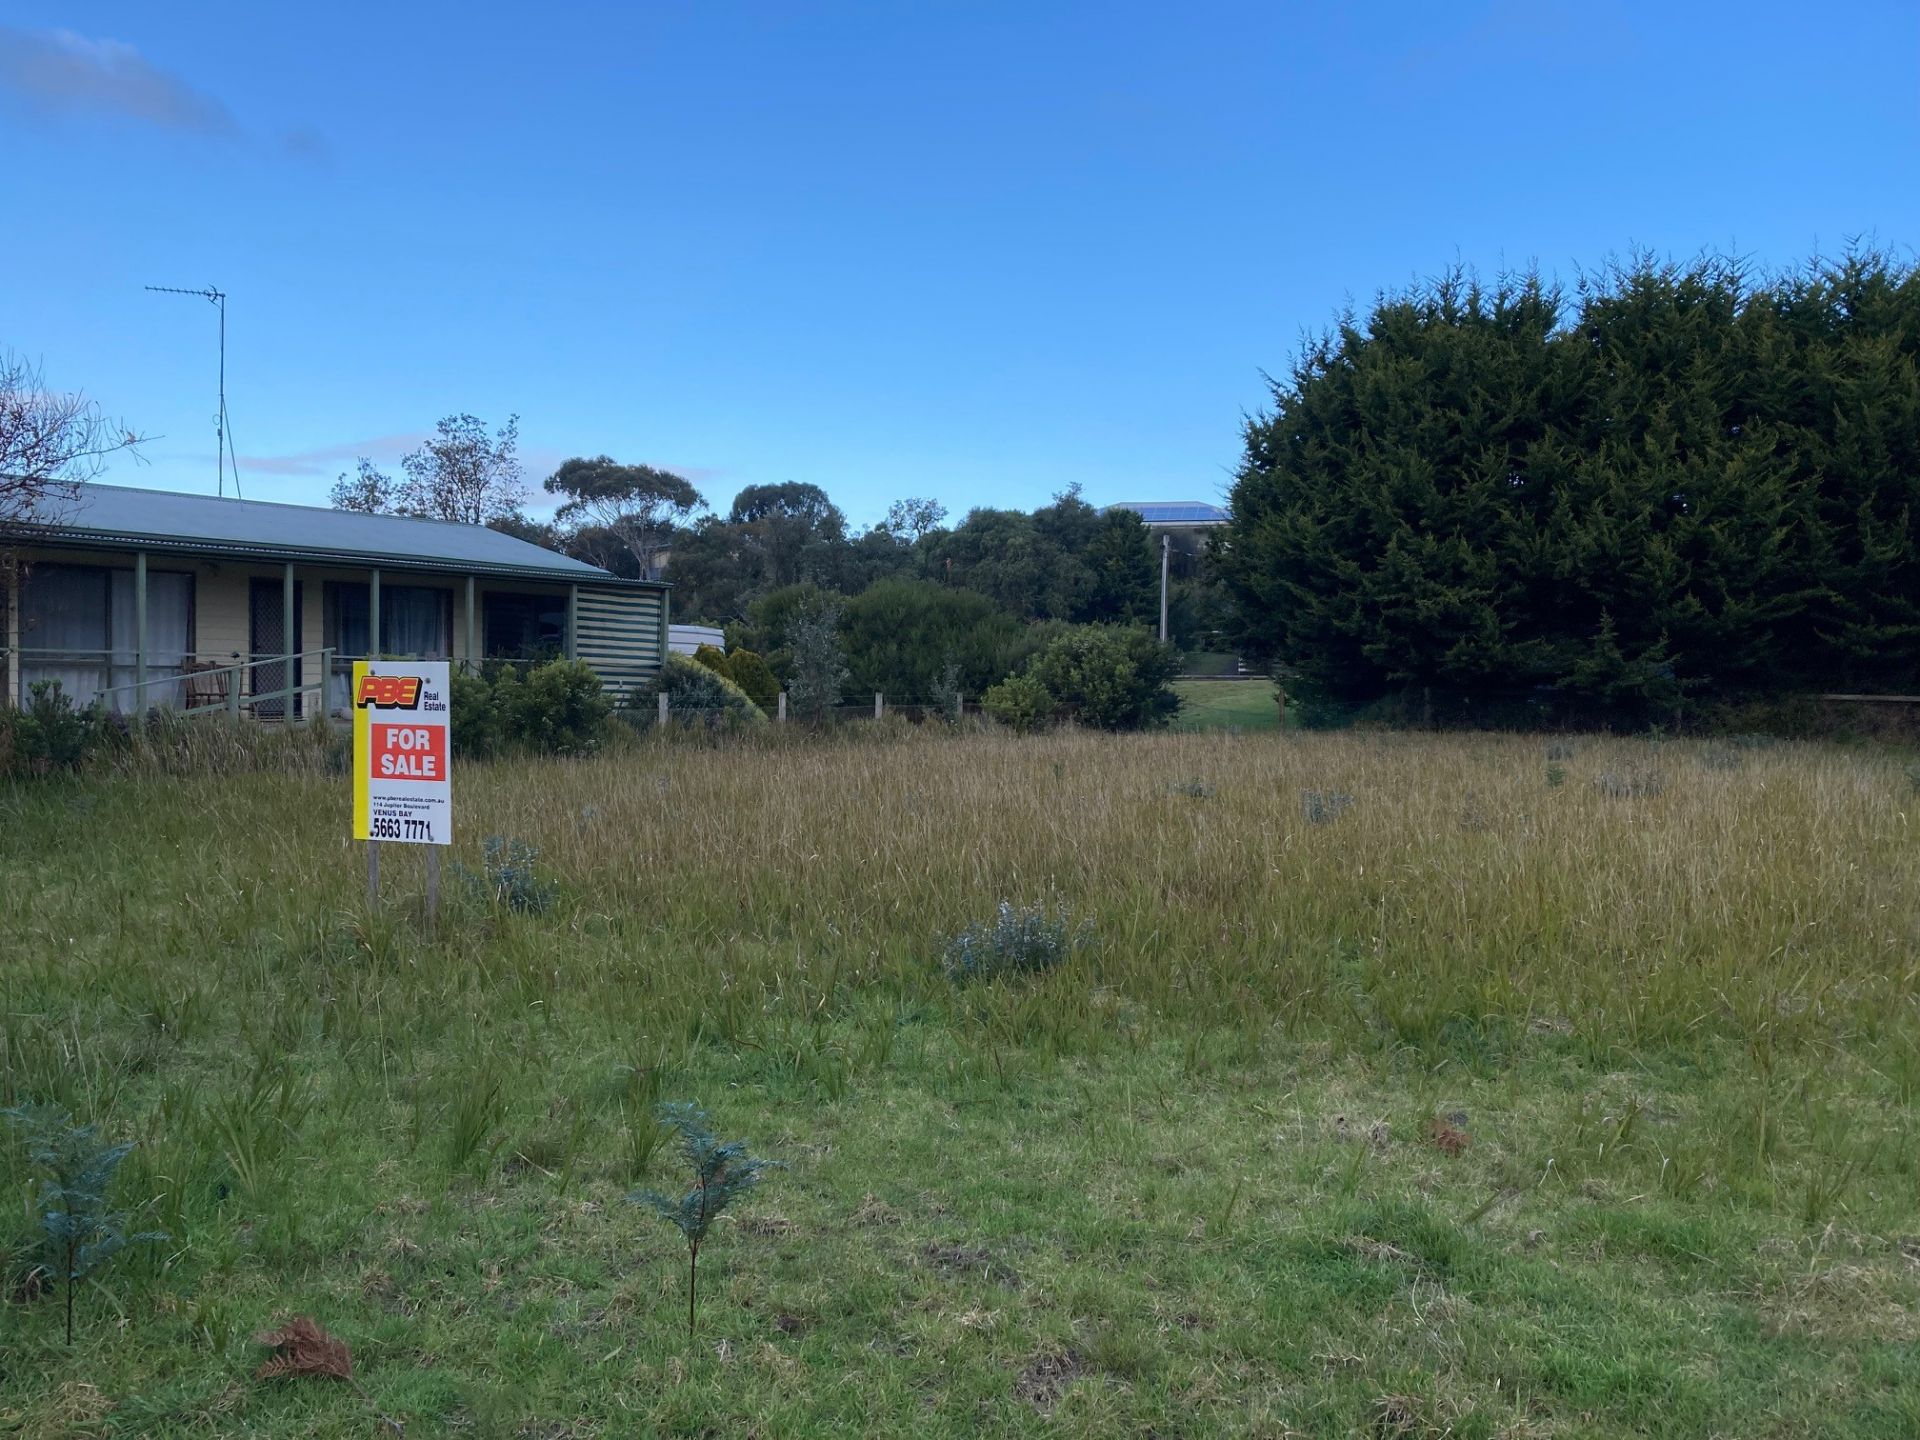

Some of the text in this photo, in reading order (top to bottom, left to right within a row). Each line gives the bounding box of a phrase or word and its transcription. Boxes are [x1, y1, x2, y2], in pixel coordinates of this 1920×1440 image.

[357, 676, 423, 710] PBE
[424, 691, 439, 701] Real
[424, 702, 446, 711] Estate
[386, 728, 430, 750] FOR
[381, 753, 436, 777] SALE
[373, 795, 445, 804] www.pberealestate.com.au
[373, 809, 413, 818] VENUS BAY
[373, 818, 431, 840] 5663 7771
